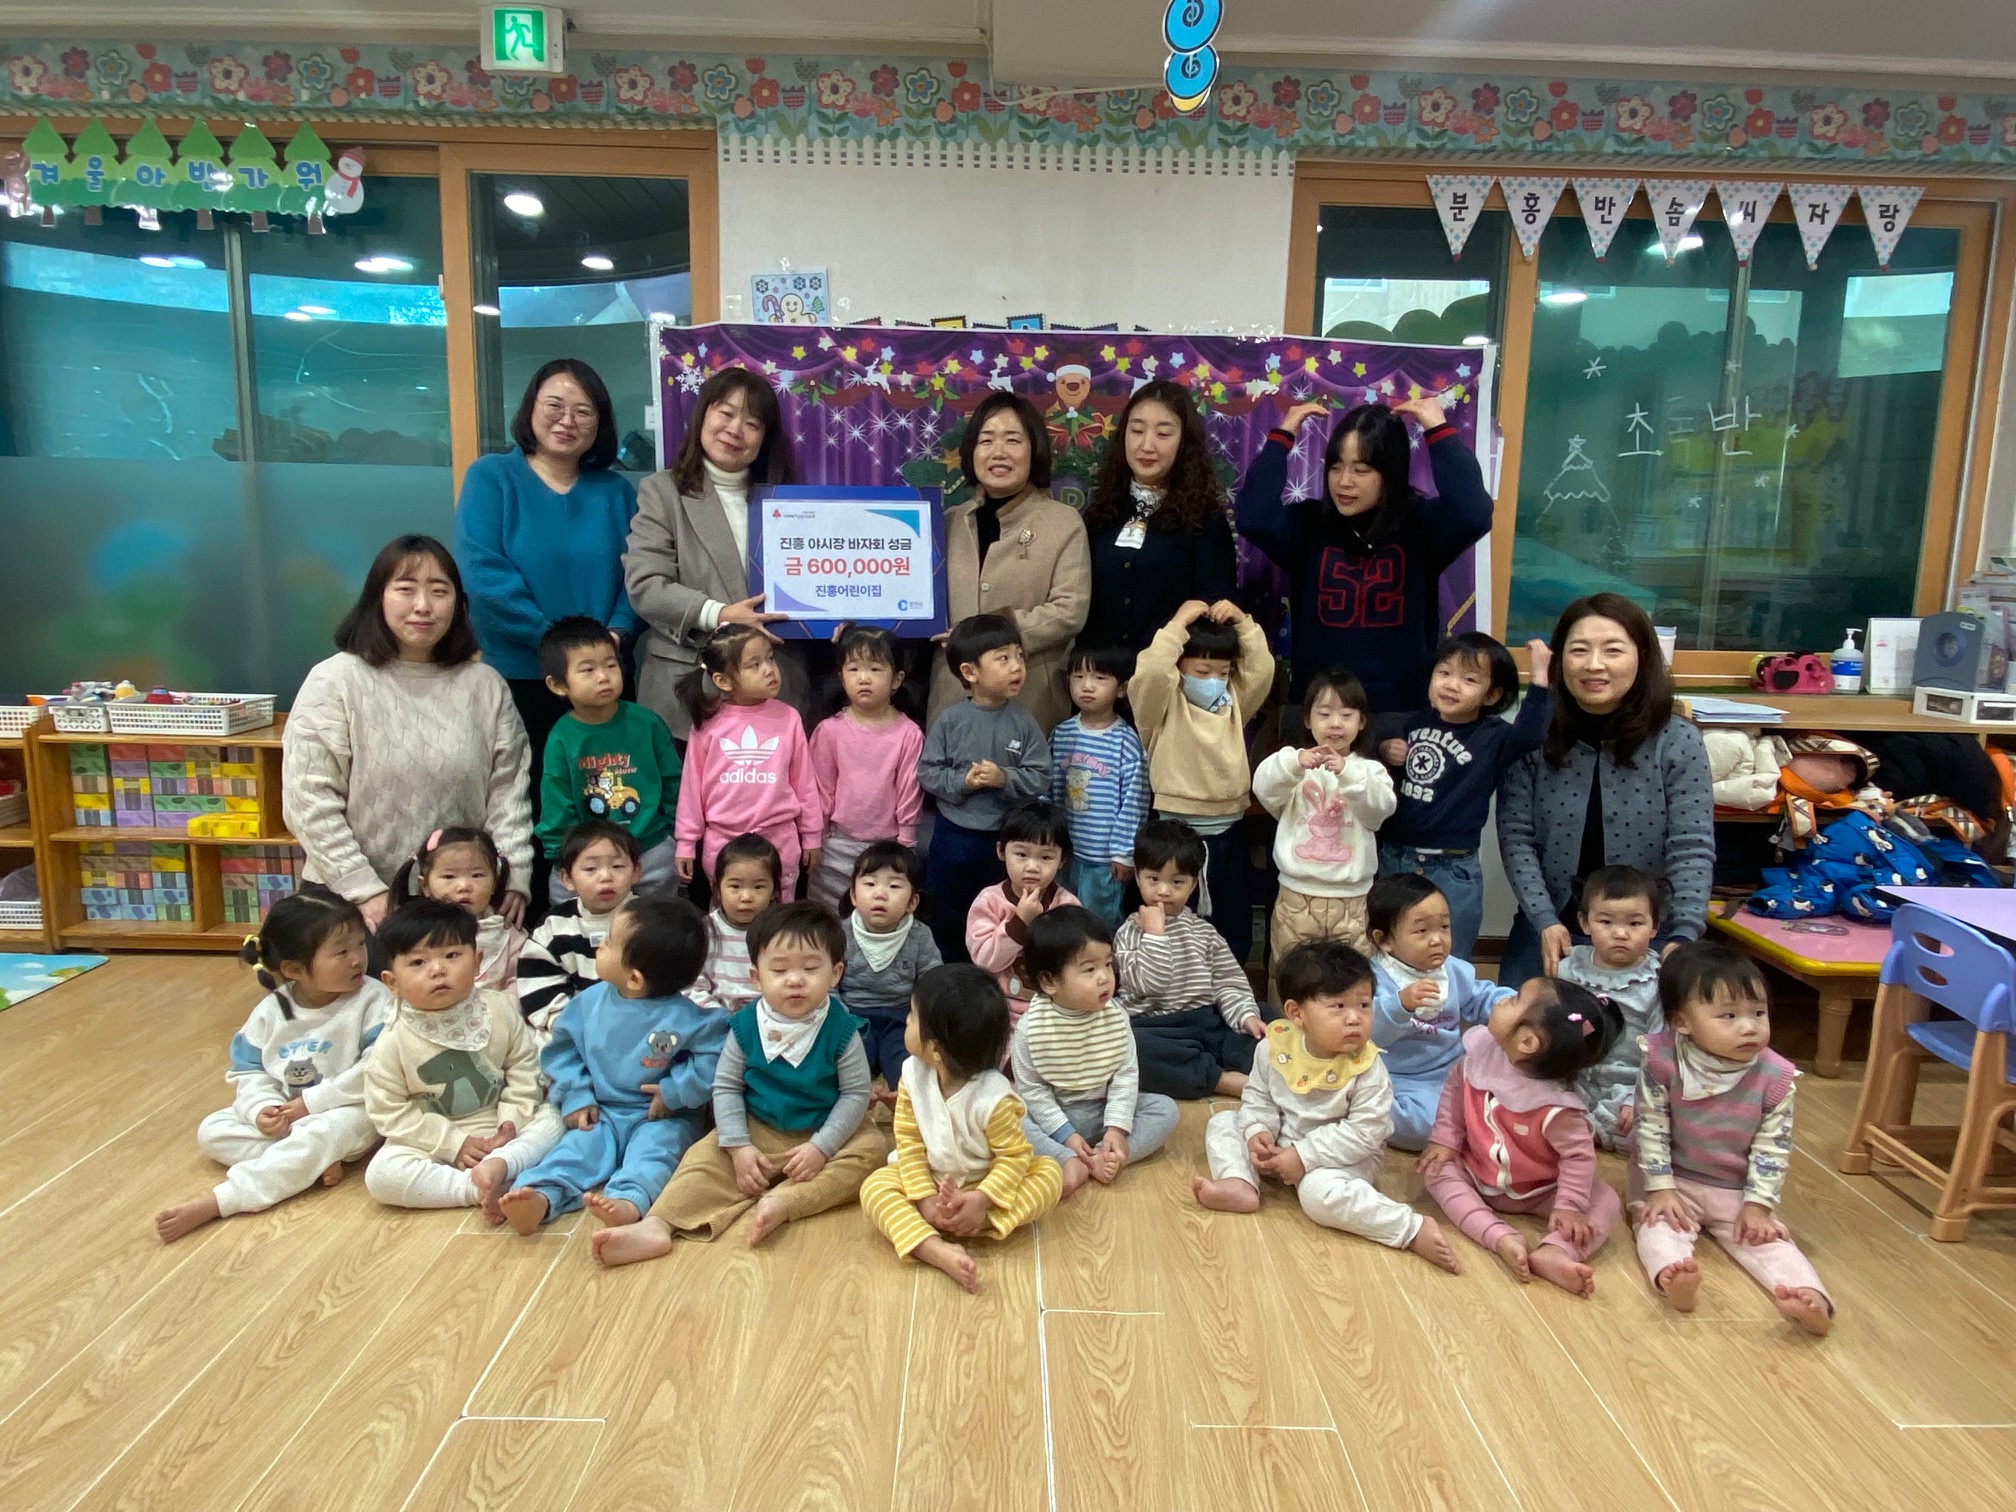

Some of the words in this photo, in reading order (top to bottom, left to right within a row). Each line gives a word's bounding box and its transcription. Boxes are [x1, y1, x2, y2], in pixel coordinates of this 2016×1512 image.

[1449, 191, 1617, 225] 분홍반
[1665, 196, 1901, 233] 솜씨자랑
[808, 538, 846, 551] 야시장
[849, 538, 885, 551] 바자회
[888, 538, 912, 551] 성금
[784, 557, 803, 576] 금
[807, 556, 911, 578] 600,000원
[1318, 544, 1405, 628] 52
[720, 767, 777, 784] adidas
